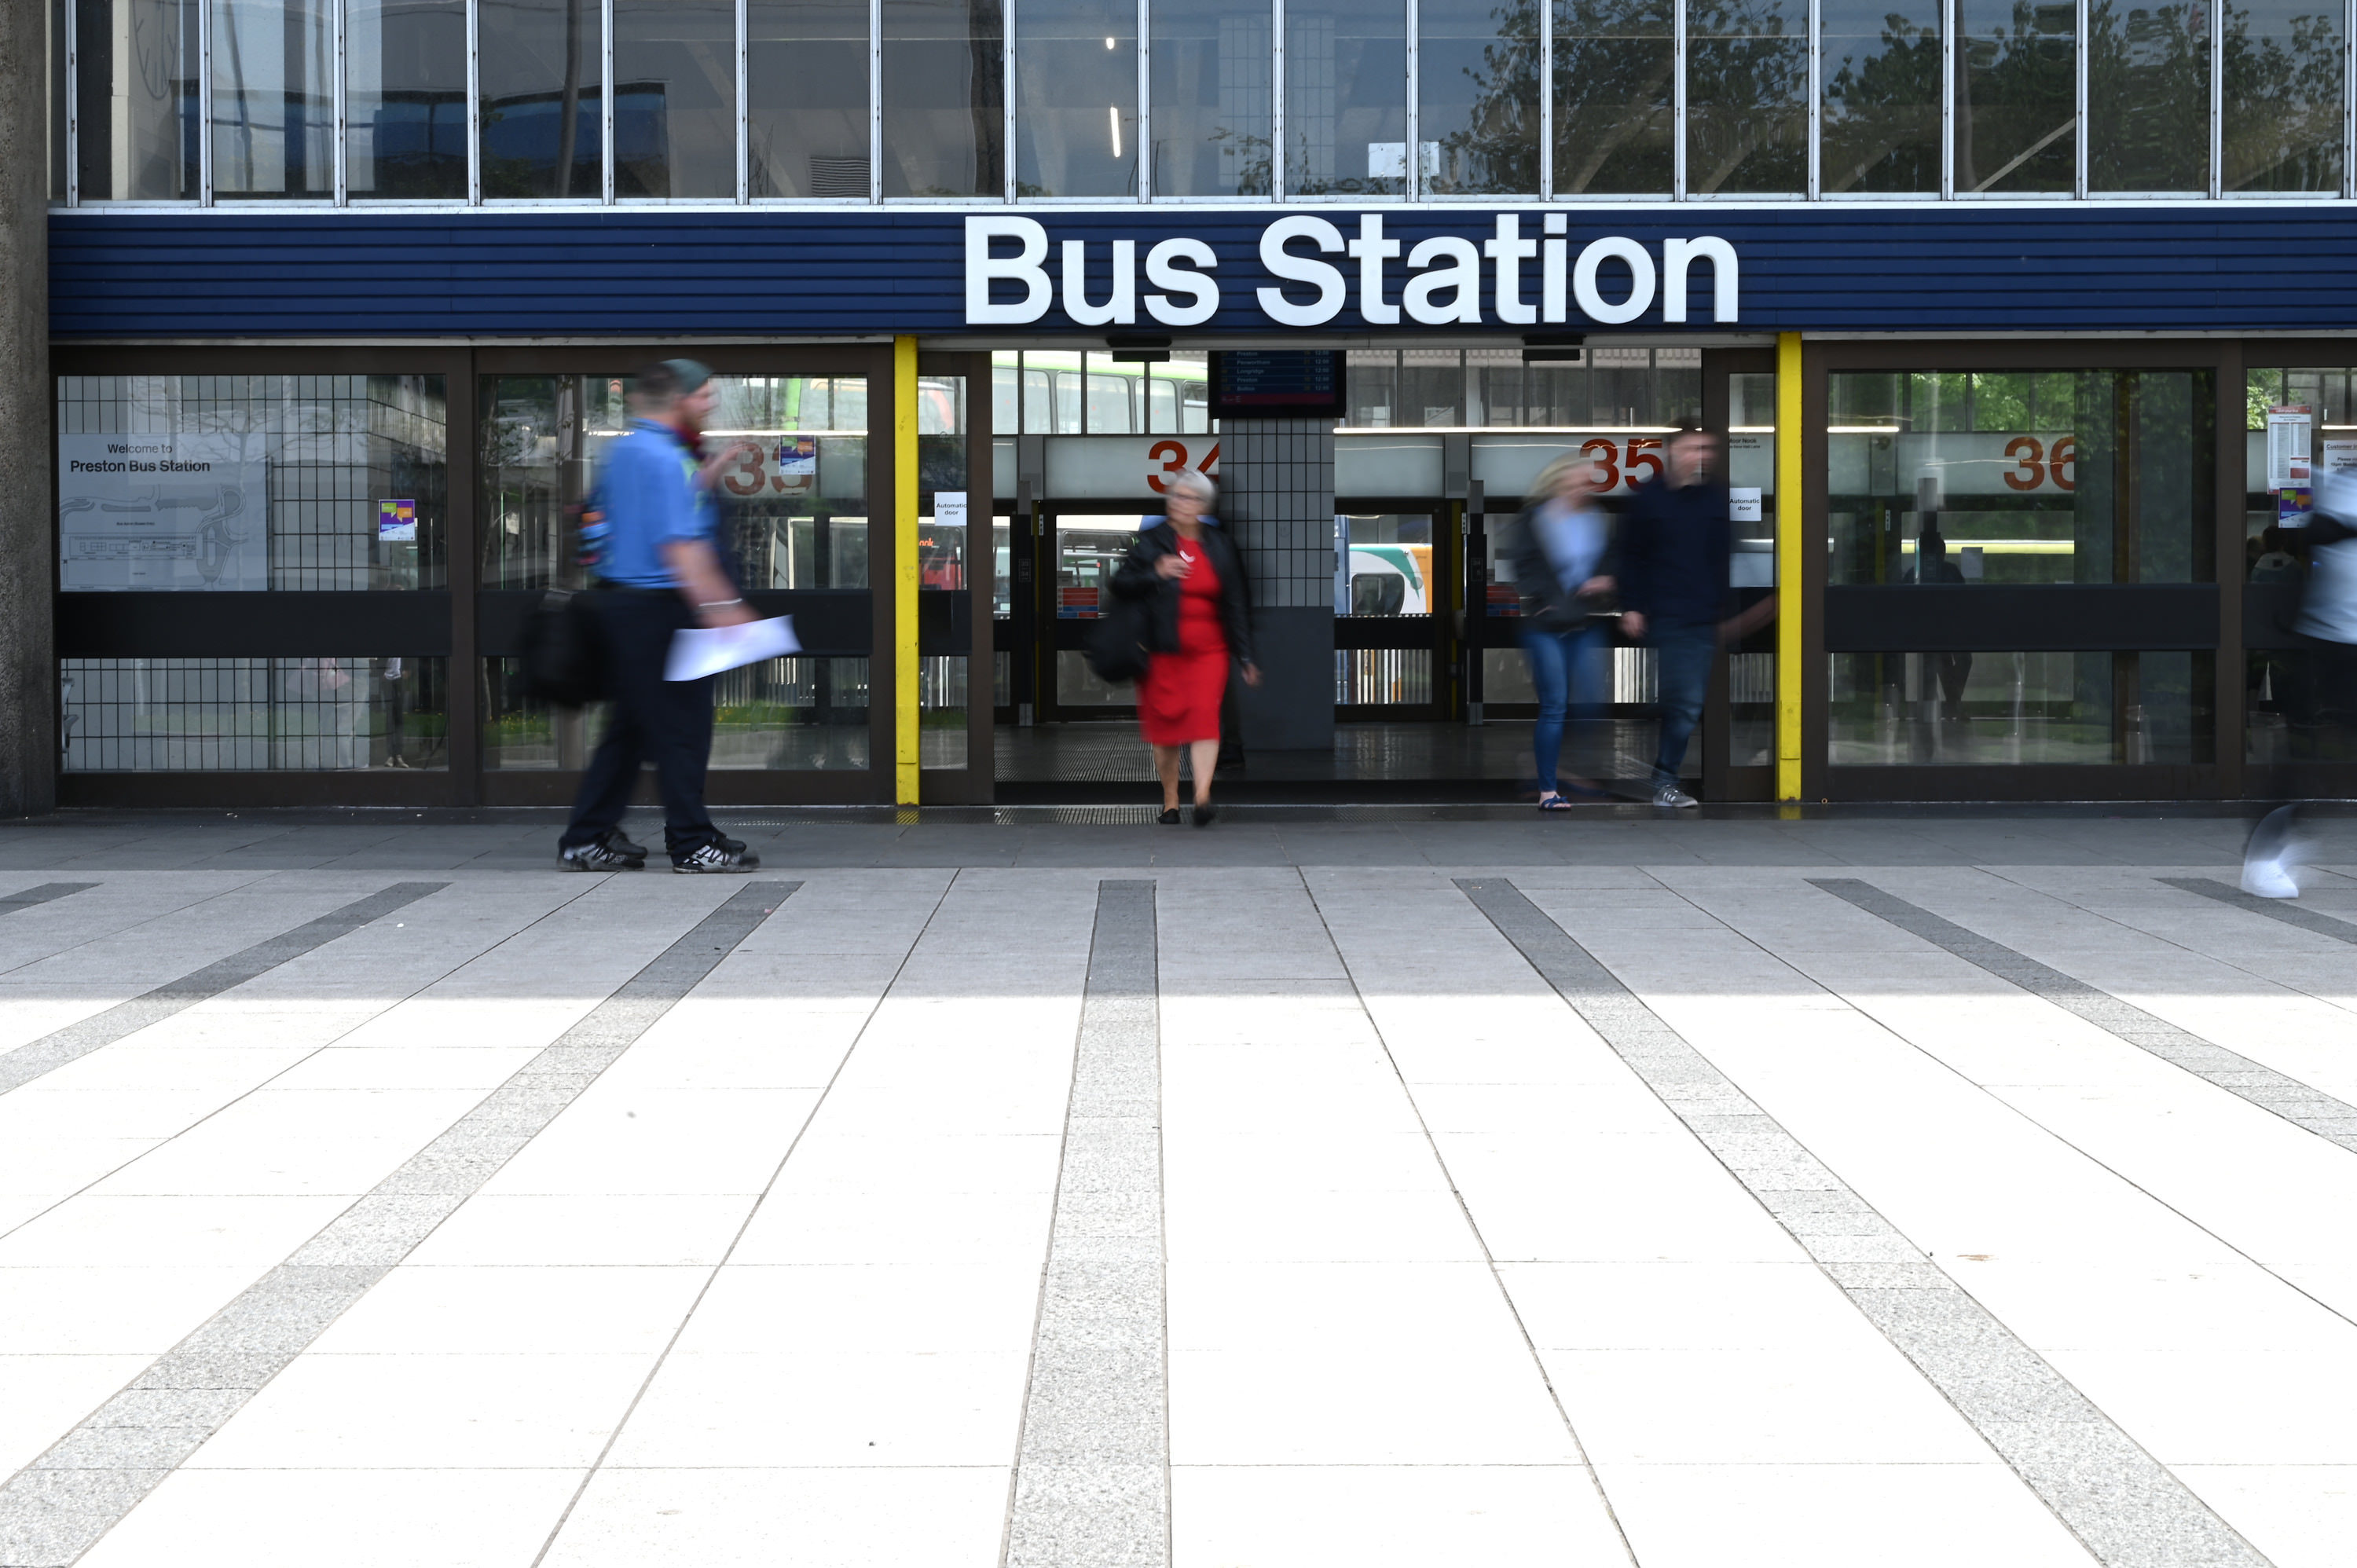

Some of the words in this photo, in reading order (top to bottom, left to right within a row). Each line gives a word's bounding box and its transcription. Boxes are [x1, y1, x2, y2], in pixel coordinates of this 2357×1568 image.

[965, 214, 1219, 327] Bus
[1257, 214, 1738, 327] Station
[107, 444, 159, 453] Welcome
[161, 444, 173, 453] to
[71, 460, 126, 472] Preston
[129, 460, 156, 472] Bus
[159, 460, 211, 472] Station
[1579, 438, 1664, 493] 35
